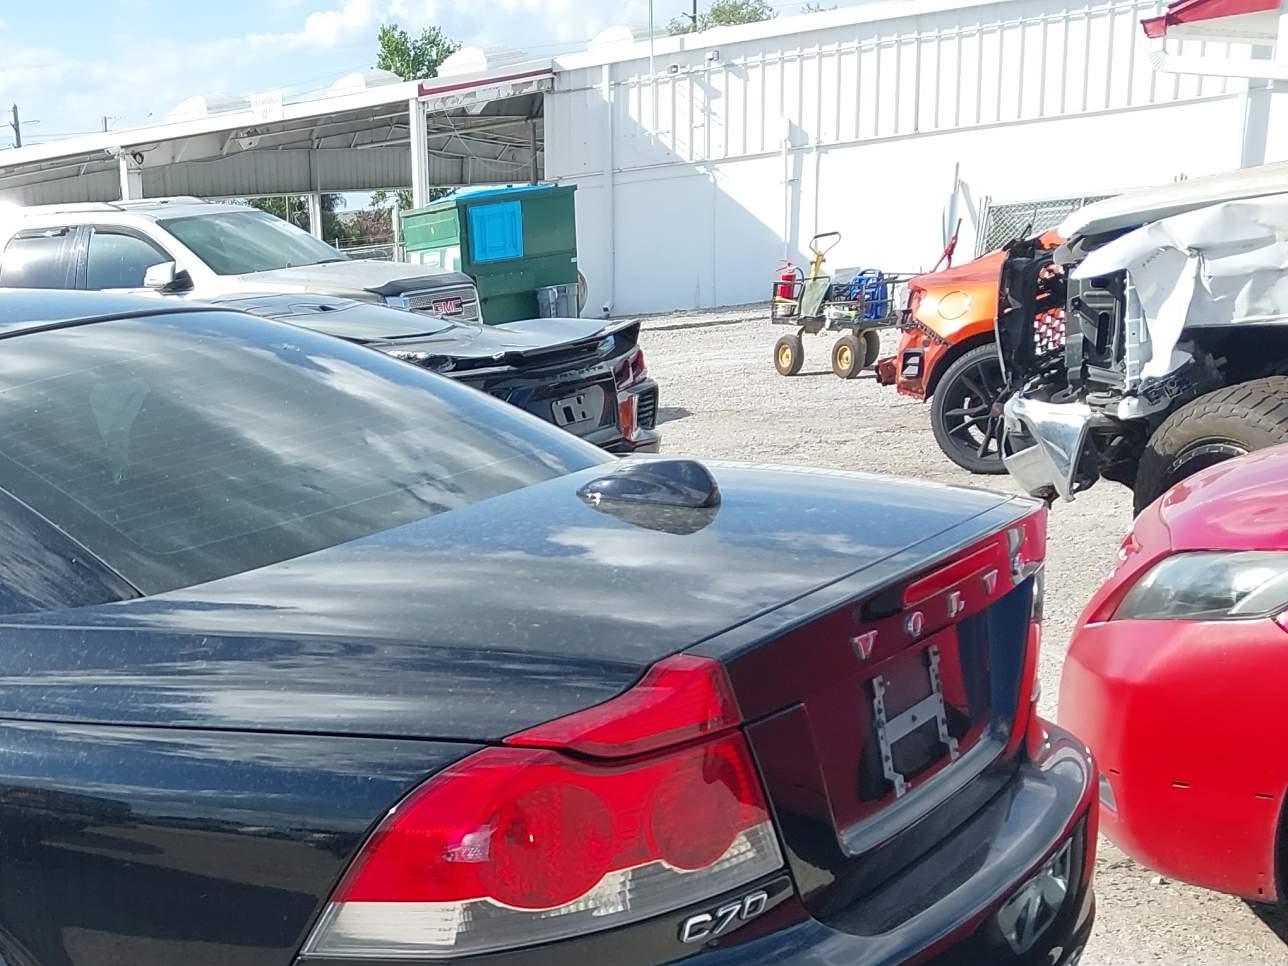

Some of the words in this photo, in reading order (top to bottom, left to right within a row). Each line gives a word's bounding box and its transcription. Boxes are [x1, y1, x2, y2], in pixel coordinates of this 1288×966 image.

[433, 300, 463, 314] GMC
[851, 553, 1024, 660] VOLVO
[680, 890, 768, 943] C70
